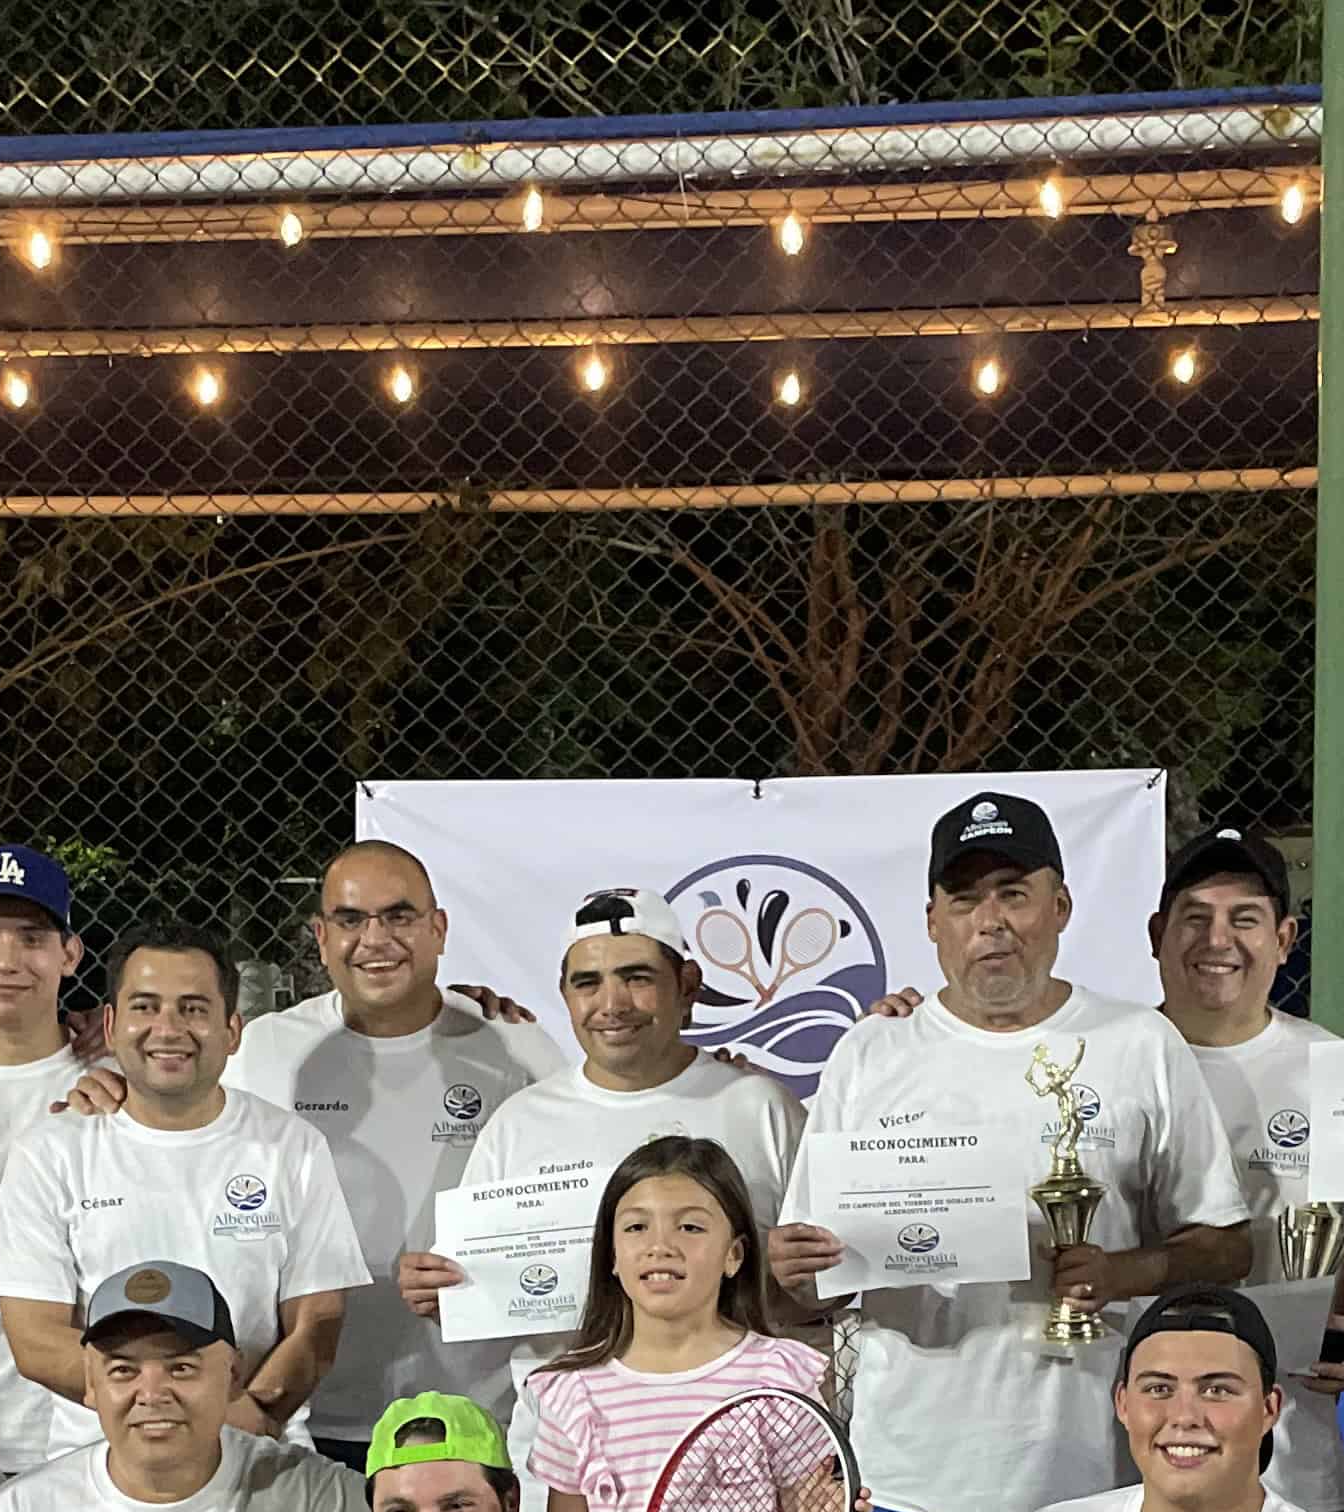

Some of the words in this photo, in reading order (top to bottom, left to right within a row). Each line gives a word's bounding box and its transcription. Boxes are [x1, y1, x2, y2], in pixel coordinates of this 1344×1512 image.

[294, 1101, 349, 1112] Gerardo
[880, 1110, 927, 1129] Victor
[850, 1135, 978, 1151] RECONOCIMIENTO
[898, 1155, 928, 1164] PARA:
[539, 1160, 594, 1175] Eduardo
[472, 1177, 589, 1202] RECONOCIMIENTO
[81, 1196, 125, 1211] César
[516, 1200, 545, 1209] PARA:
